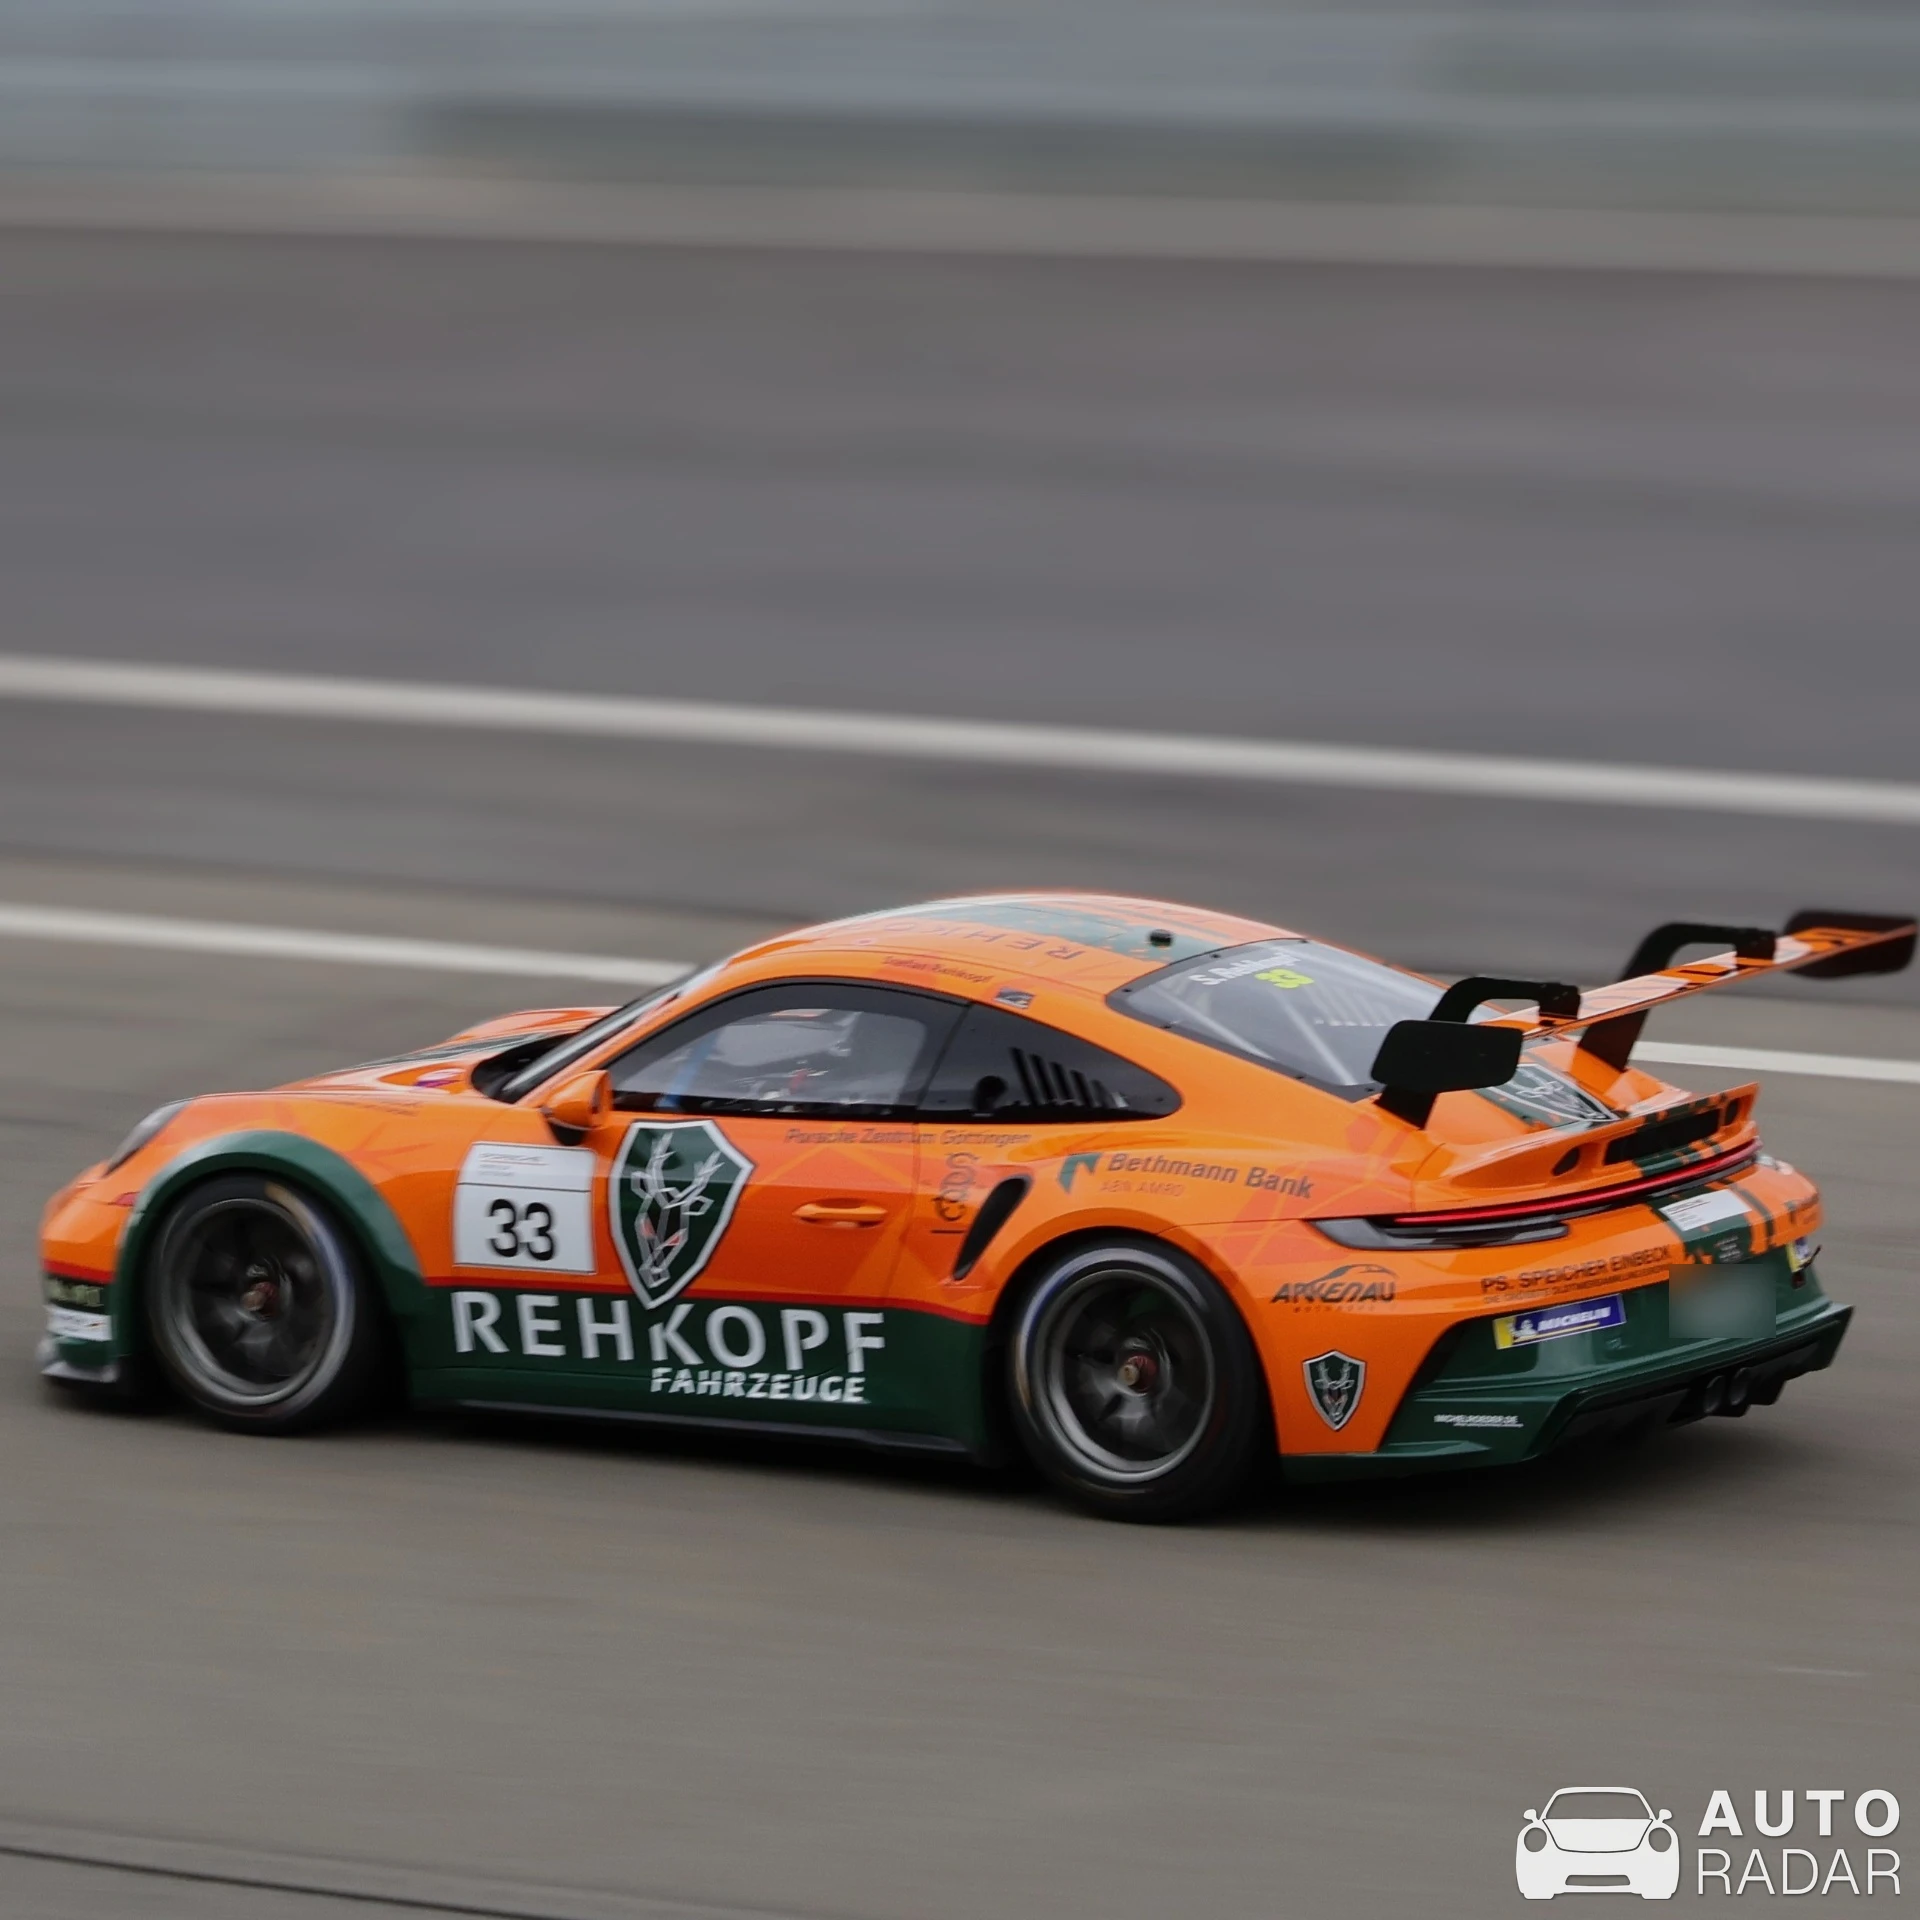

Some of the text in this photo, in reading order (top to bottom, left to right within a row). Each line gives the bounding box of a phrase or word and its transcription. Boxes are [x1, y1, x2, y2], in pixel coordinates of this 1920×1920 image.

[784, 1128, 858, 1144] Porsche
[859, 1128, 937, 1145] Zentrum
[1107, 1152, 1315, 1199] Bethmann Bank
[485, 1198, 556, 1261] 33
[450, 1290, 887, 1373] REHKOPF
[650, 1367, 867, 1403] FAHRZEUGE
